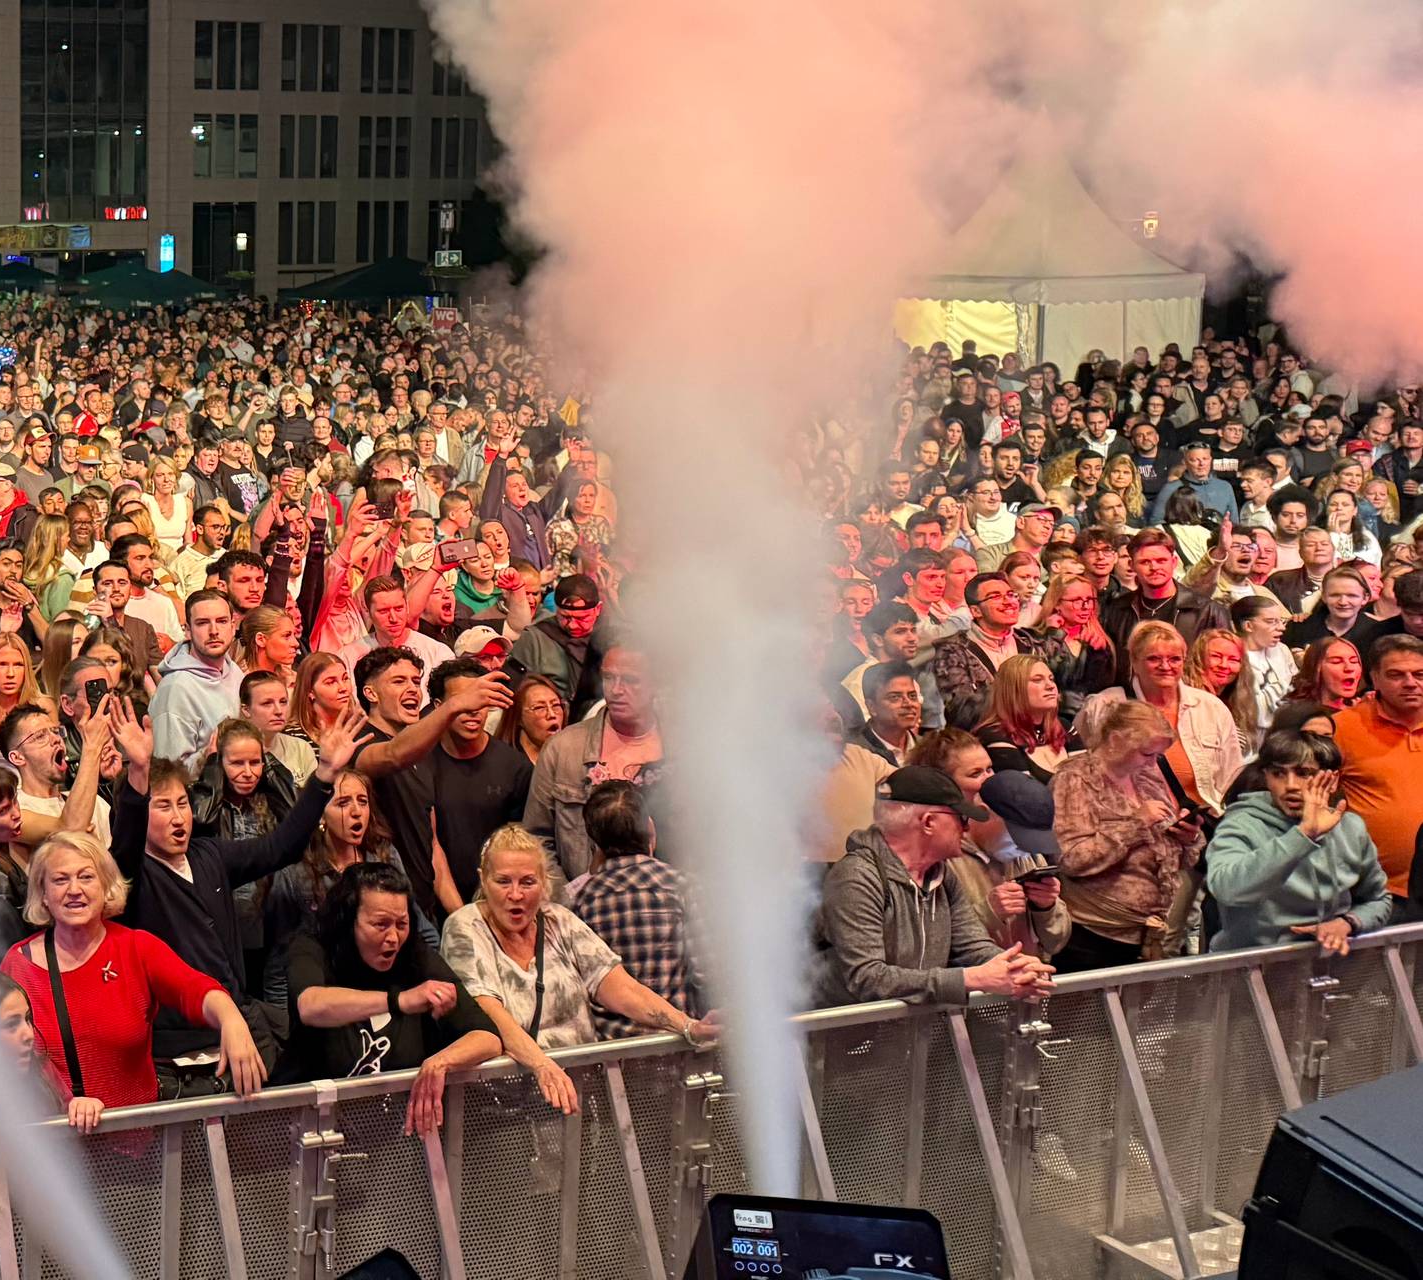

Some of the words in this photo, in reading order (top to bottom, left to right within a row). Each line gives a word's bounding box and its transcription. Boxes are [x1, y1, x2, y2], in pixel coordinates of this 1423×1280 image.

[435, 310, 455, 321] WC
[732, 1243, 754, 1255] 002
[757, 1245, 778, 1257] 001
[874, 1252, 915, 1269] FX
